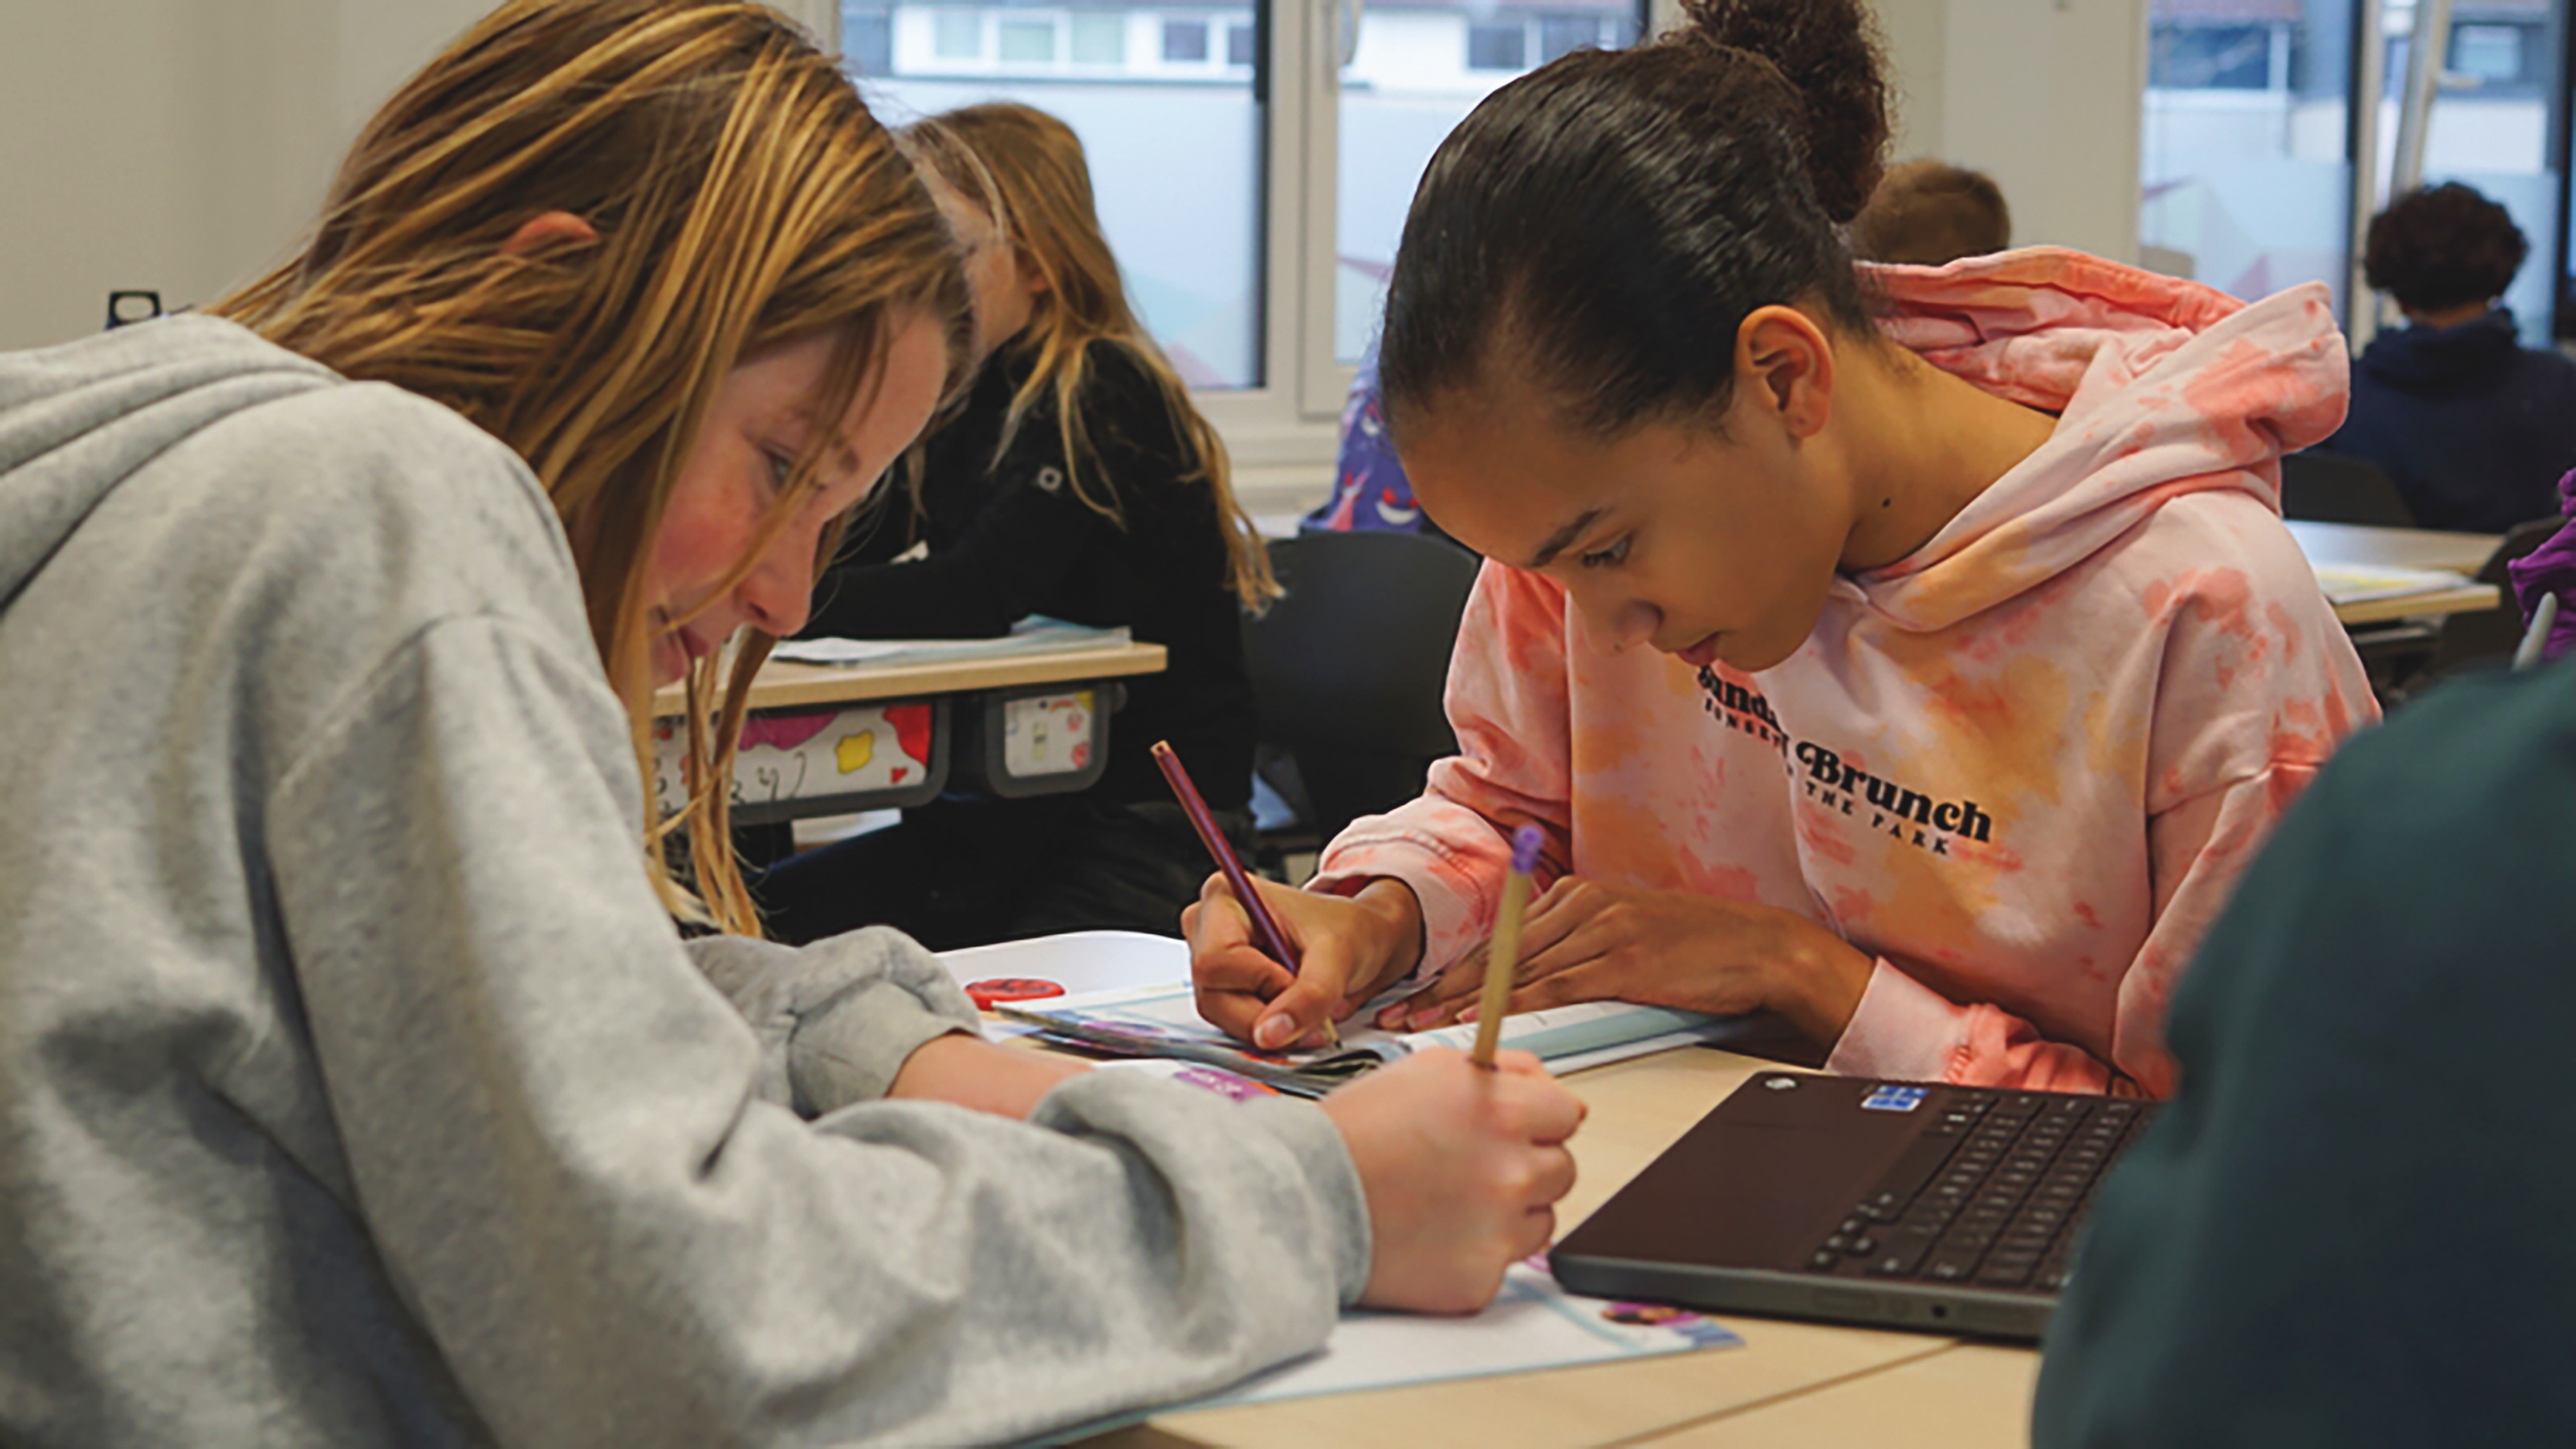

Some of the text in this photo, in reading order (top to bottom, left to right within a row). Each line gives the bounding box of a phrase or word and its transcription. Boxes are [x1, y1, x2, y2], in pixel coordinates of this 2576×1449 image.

[1795, 741, 1991, 843] Brunch
[1805, 780, 1853, 816] THE
[1871, 812, 1948, 855] PARK
